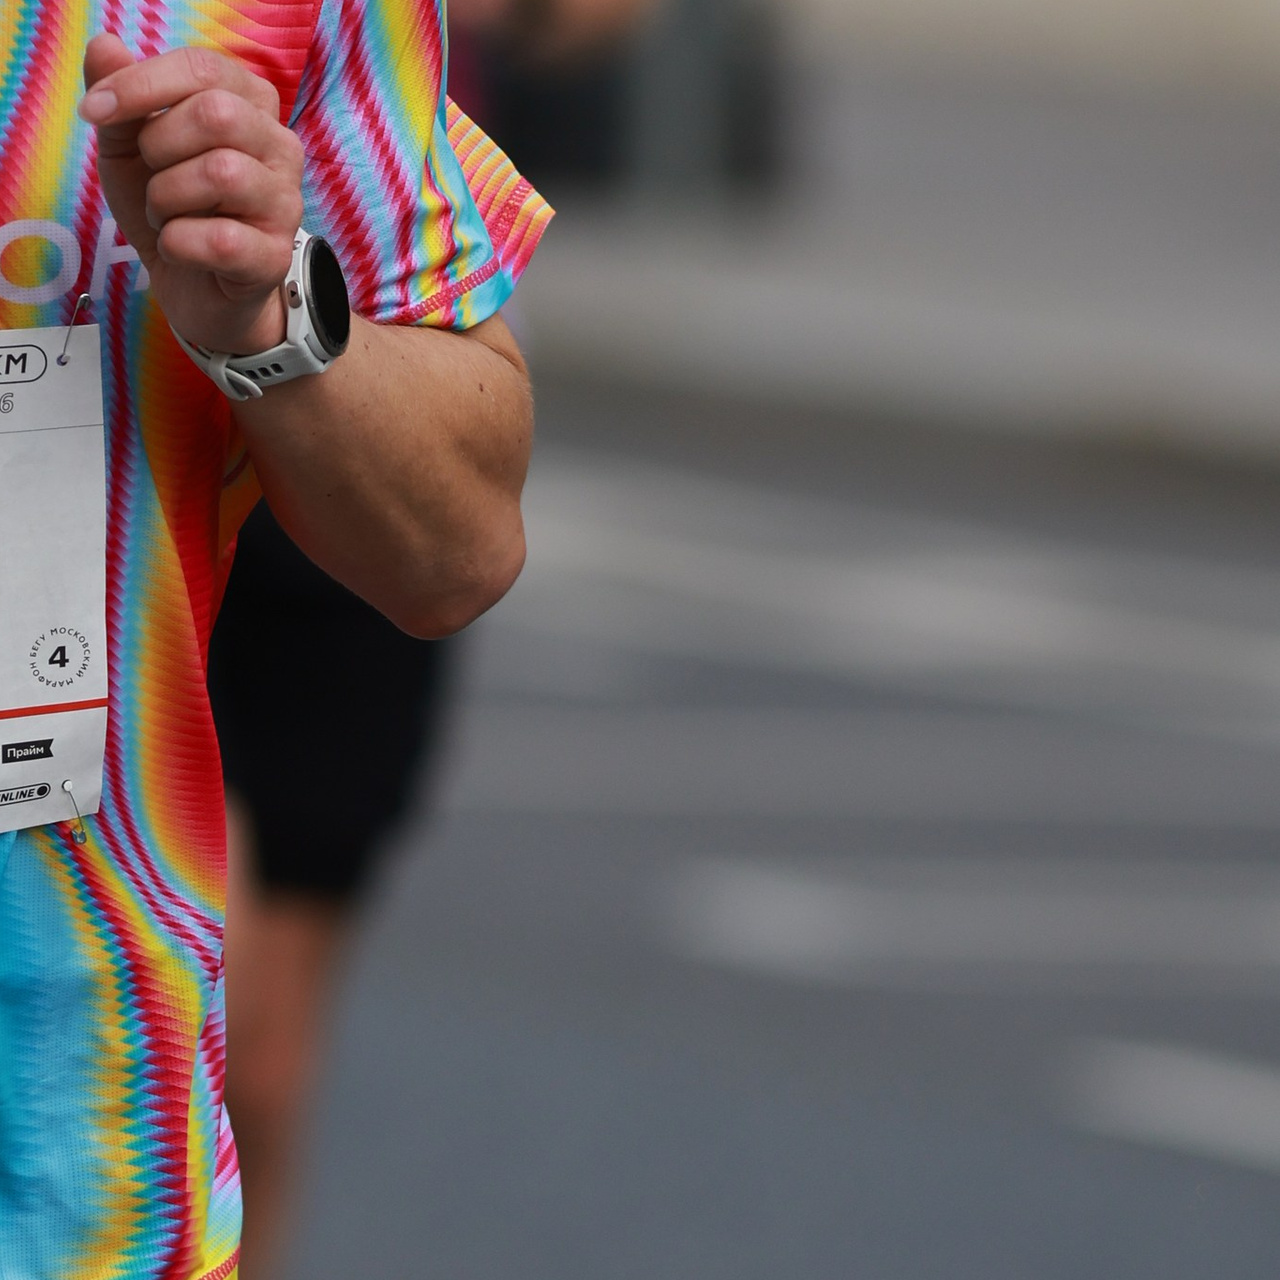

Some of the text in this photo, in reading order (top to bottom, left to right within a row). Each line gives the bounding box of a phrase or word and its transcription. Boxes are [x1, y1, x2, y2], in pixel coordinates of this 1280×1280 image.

[30, 627, 91, 688] БЕГУ МОСКОВСКИЙ МАРАФОН
[48, 645, 70, 668] 4
[7, 745, 45, 758] Прайм
